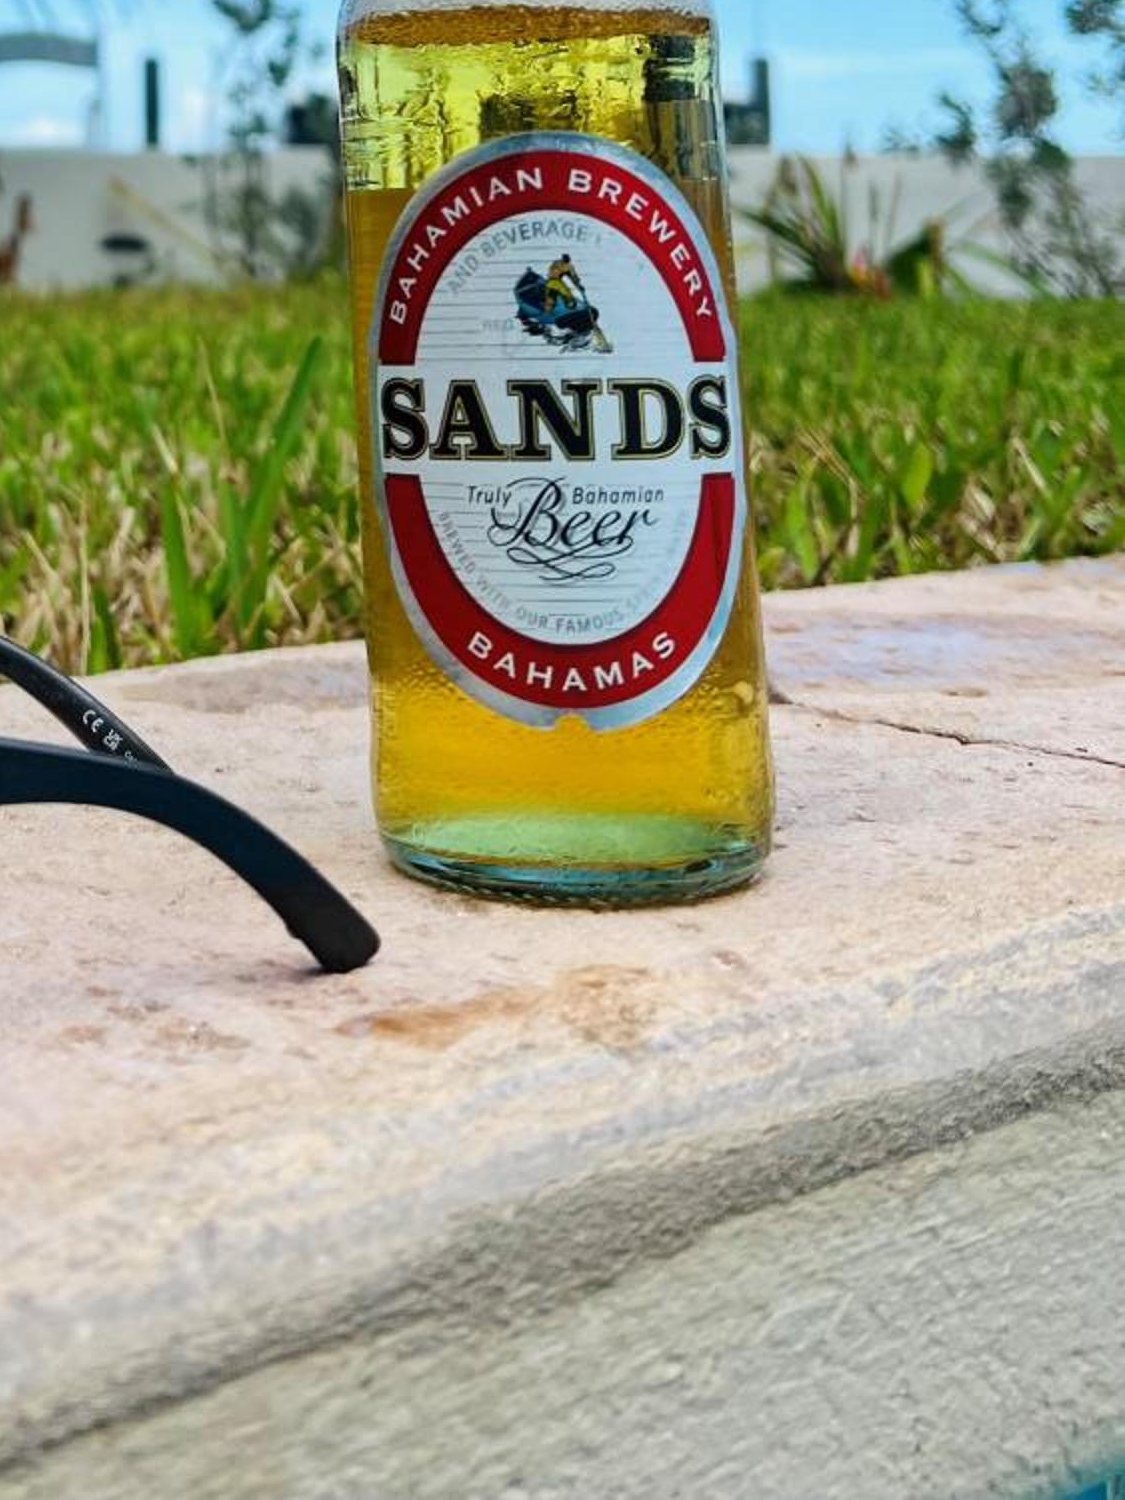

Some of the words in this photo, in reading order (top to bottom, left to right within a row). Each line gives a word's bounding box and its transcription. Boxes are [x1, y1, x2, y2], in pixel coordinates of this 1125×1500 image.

[390, 167, 543, 325] BAHAMIAN
[567, 168, 712, 319] BREWERY
[446, 254, 482, 296] AND
[481, 220, 588, 258] BEVERAGE
[380, 374, 732, 461] SANDS
[468, 485, 513, 507] Truly
[572, 486, 664, 506] Bahamian
[487, 476, 659, 570] Beer
[515, 605, 549, 630] OUR
[554, 609, 625, 634] FAMOUS
[466, 631, 677, 692] BAHAMAS
